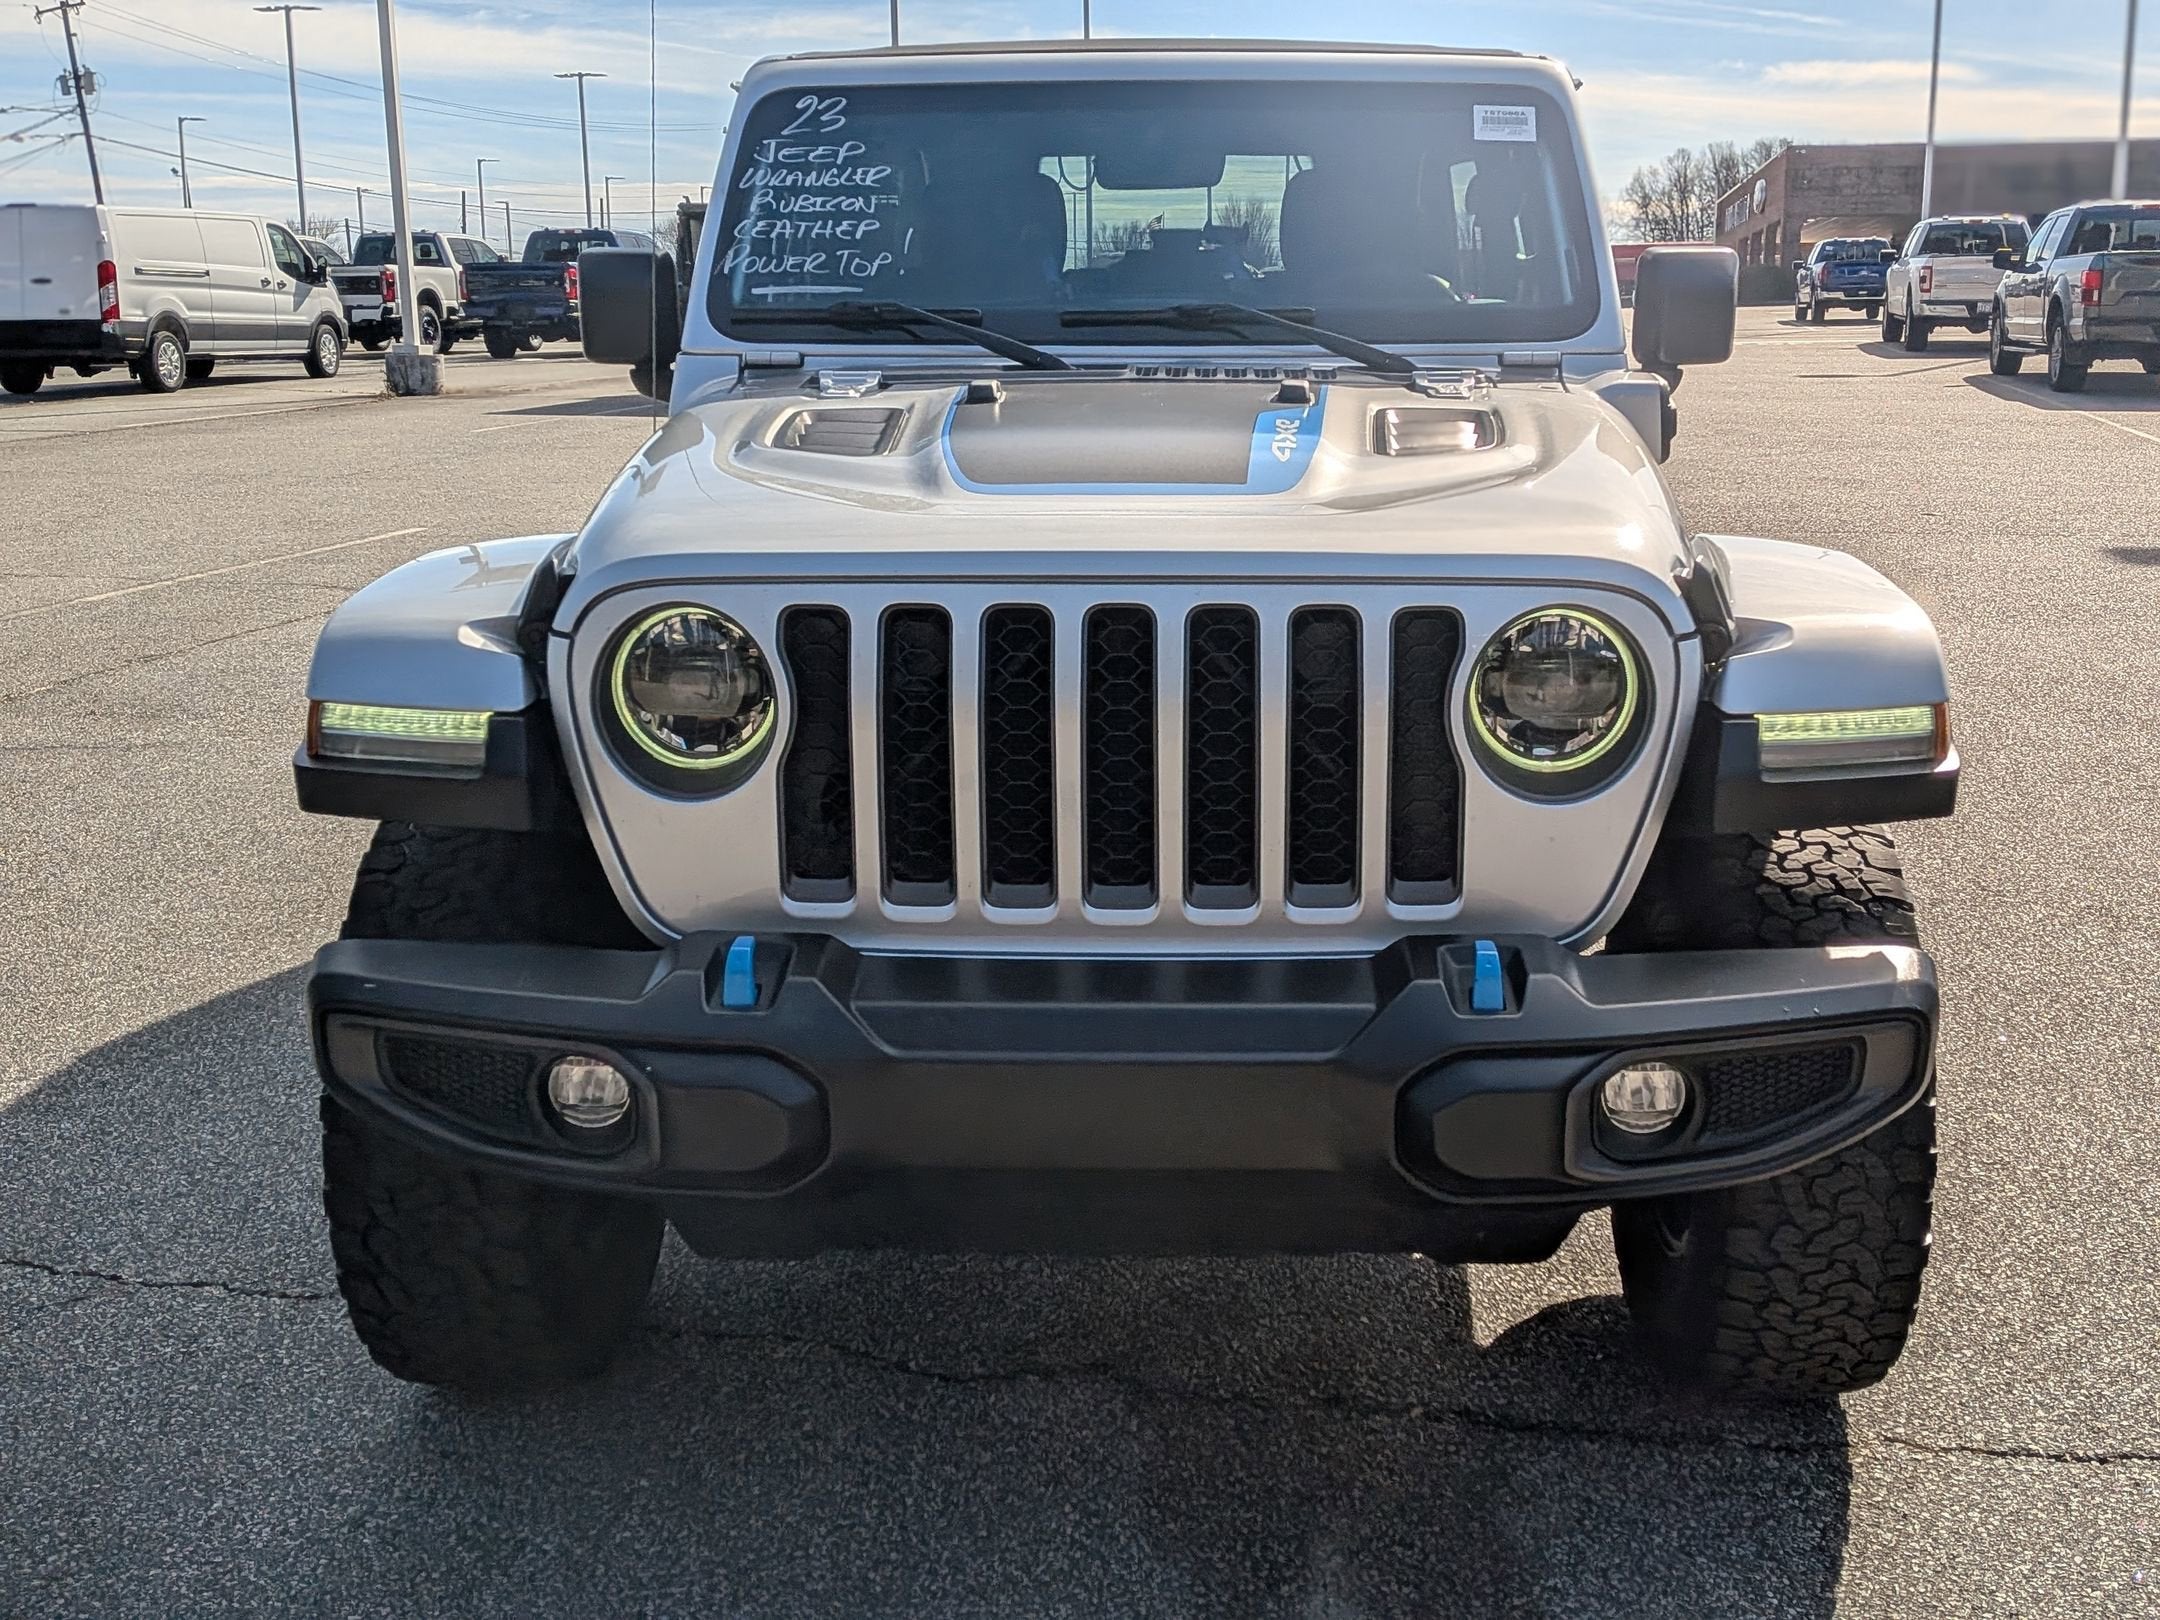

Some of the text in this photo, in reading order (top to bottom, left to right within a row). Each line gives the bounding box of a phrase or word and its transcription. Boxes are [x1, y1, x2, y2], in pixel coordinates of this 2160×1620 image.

[781, 95, 847, 136] 23
[754, 139, 866, 165] JEEP
[739, 166, 892, 189] WRANGLER
[750, 188, 876, 214] RUBICON
[723, 244, 830, 275] POWER
